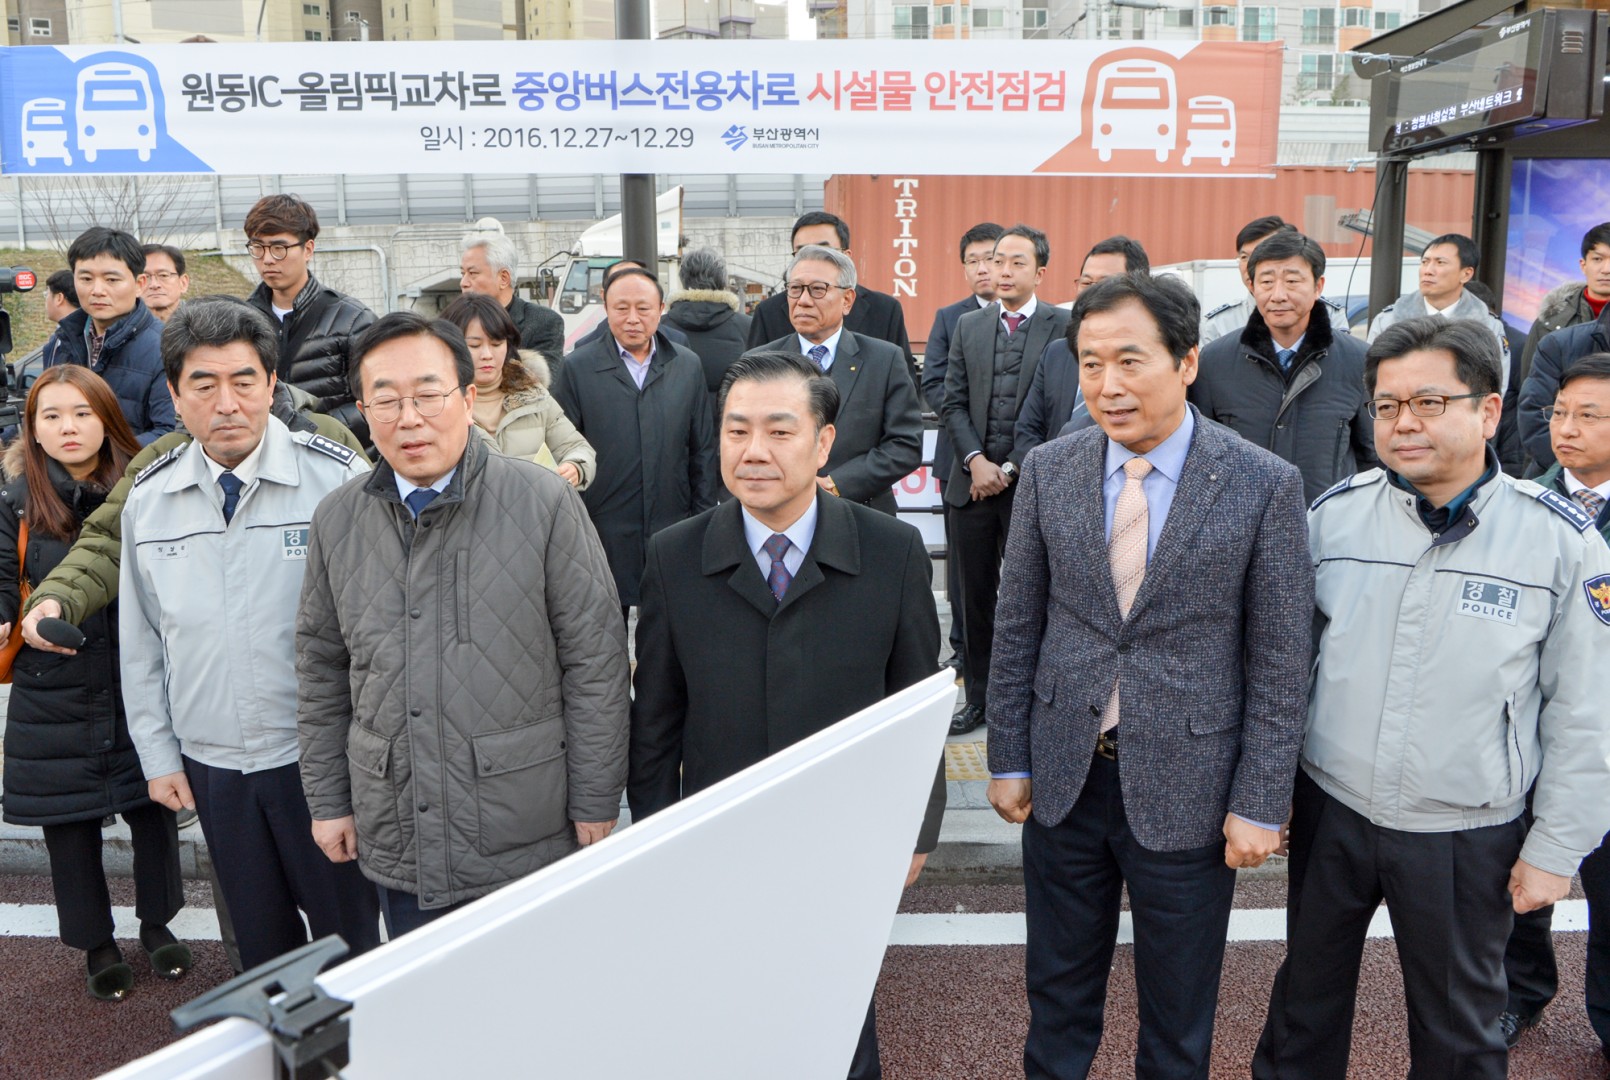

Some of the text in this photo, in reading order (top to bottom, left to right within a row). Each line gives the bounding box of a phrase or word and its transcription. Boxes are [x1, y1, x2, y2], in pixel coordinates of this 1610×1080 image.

[512, 70, 800, 112] 중앙버스전용차로
[807, 70, 917, 112] 시설물
[925, 70, 1066, 112] 안전점검
[420, 126, 464, 151] 일시
[483, 127, 694, 149] 2016.12.27~12.29
[752, 127, 820, 142] 부산광역시
[893, 179, 919, 297] TRITON
[287, 549, 307, 557] POL
[1462, 602, 1513, 620] POLICE
